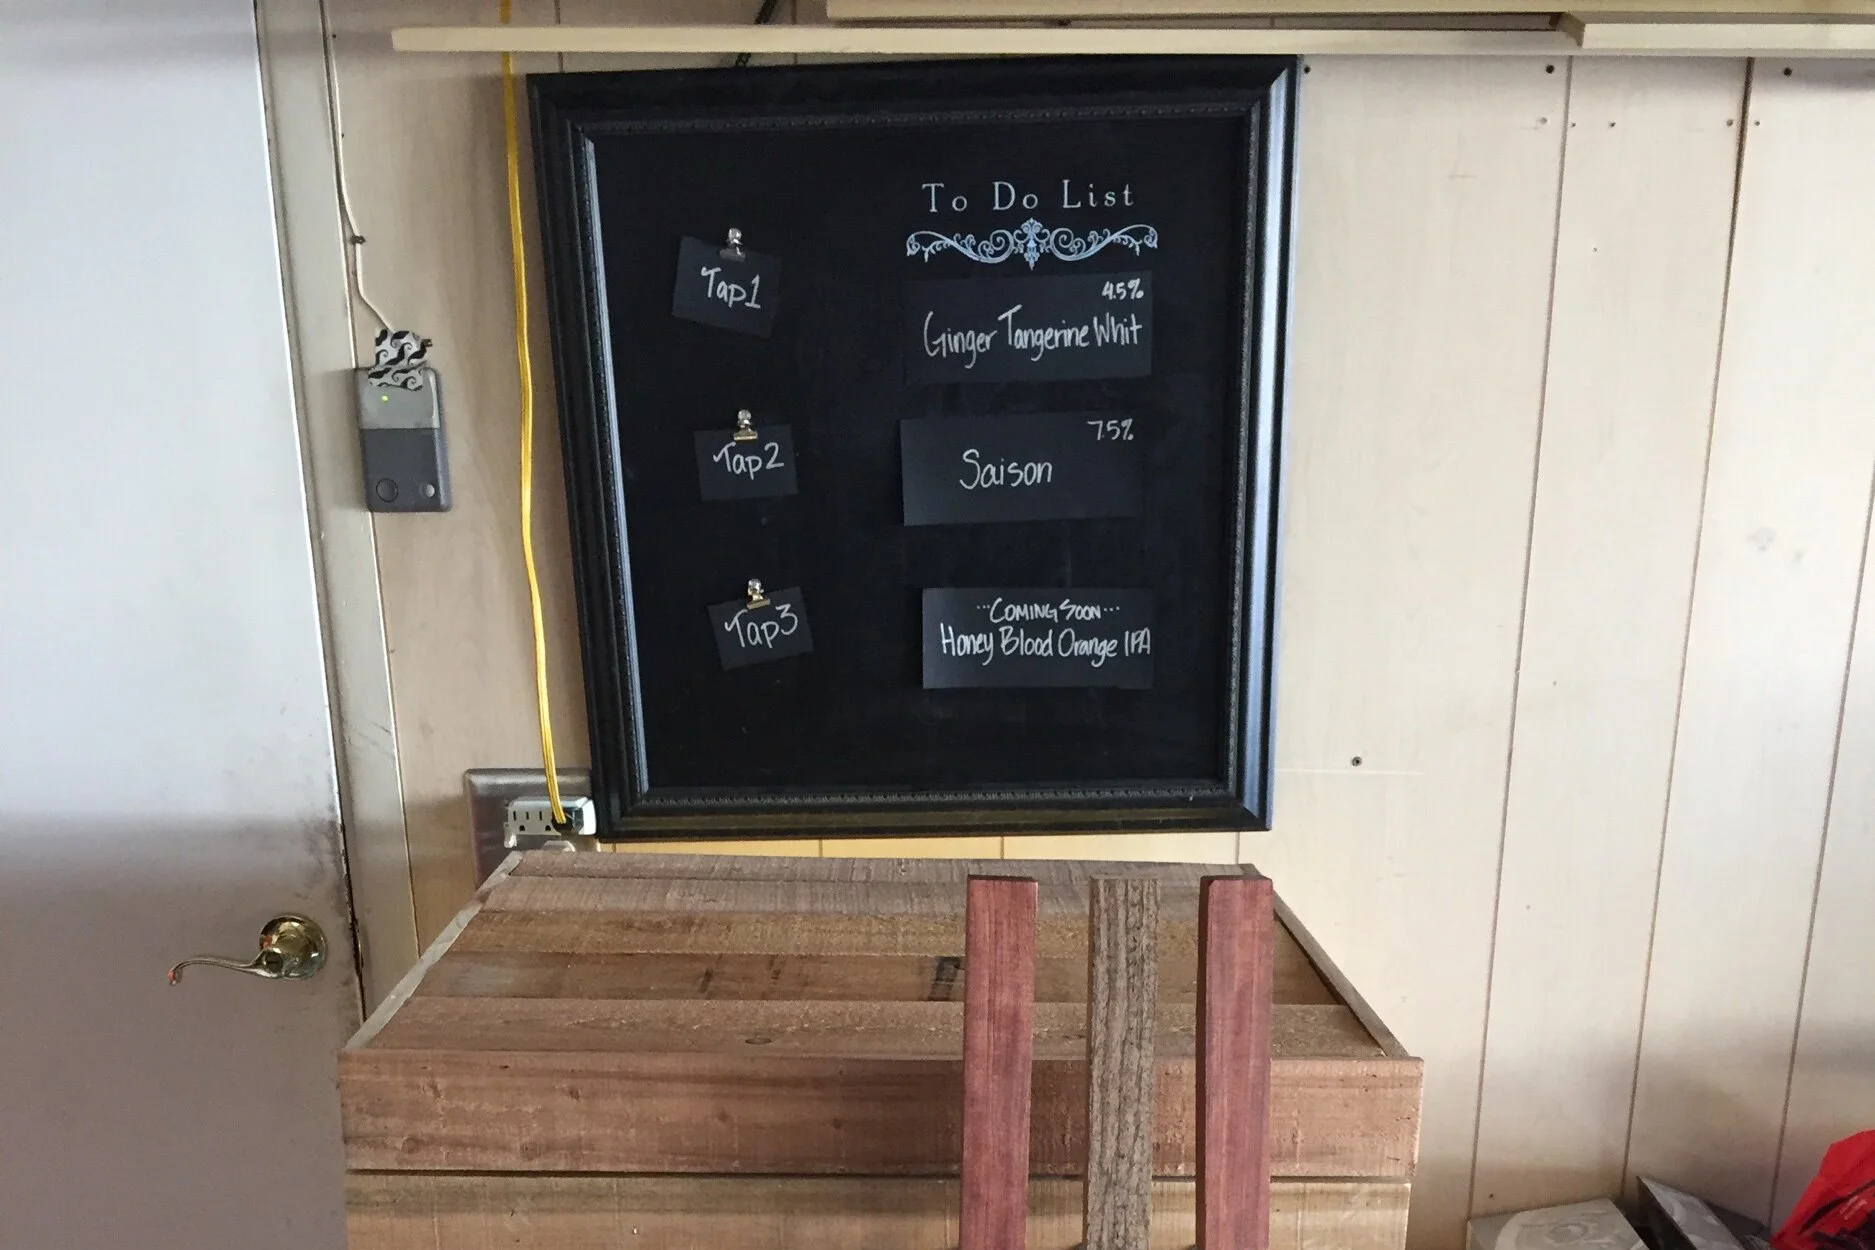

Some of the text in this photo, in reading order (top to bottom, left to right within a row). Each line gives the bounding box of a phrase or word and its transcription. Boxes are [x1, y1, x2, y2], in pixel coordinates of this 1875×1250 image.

[922, 179, 1134, 212] To Do List
[923, 304, 1143, 370] Ginger Tangerine Whit
[959, 449, 1053, 490] Saison
[940, 622, 1151, 668] Honey Blood Orange IPA
